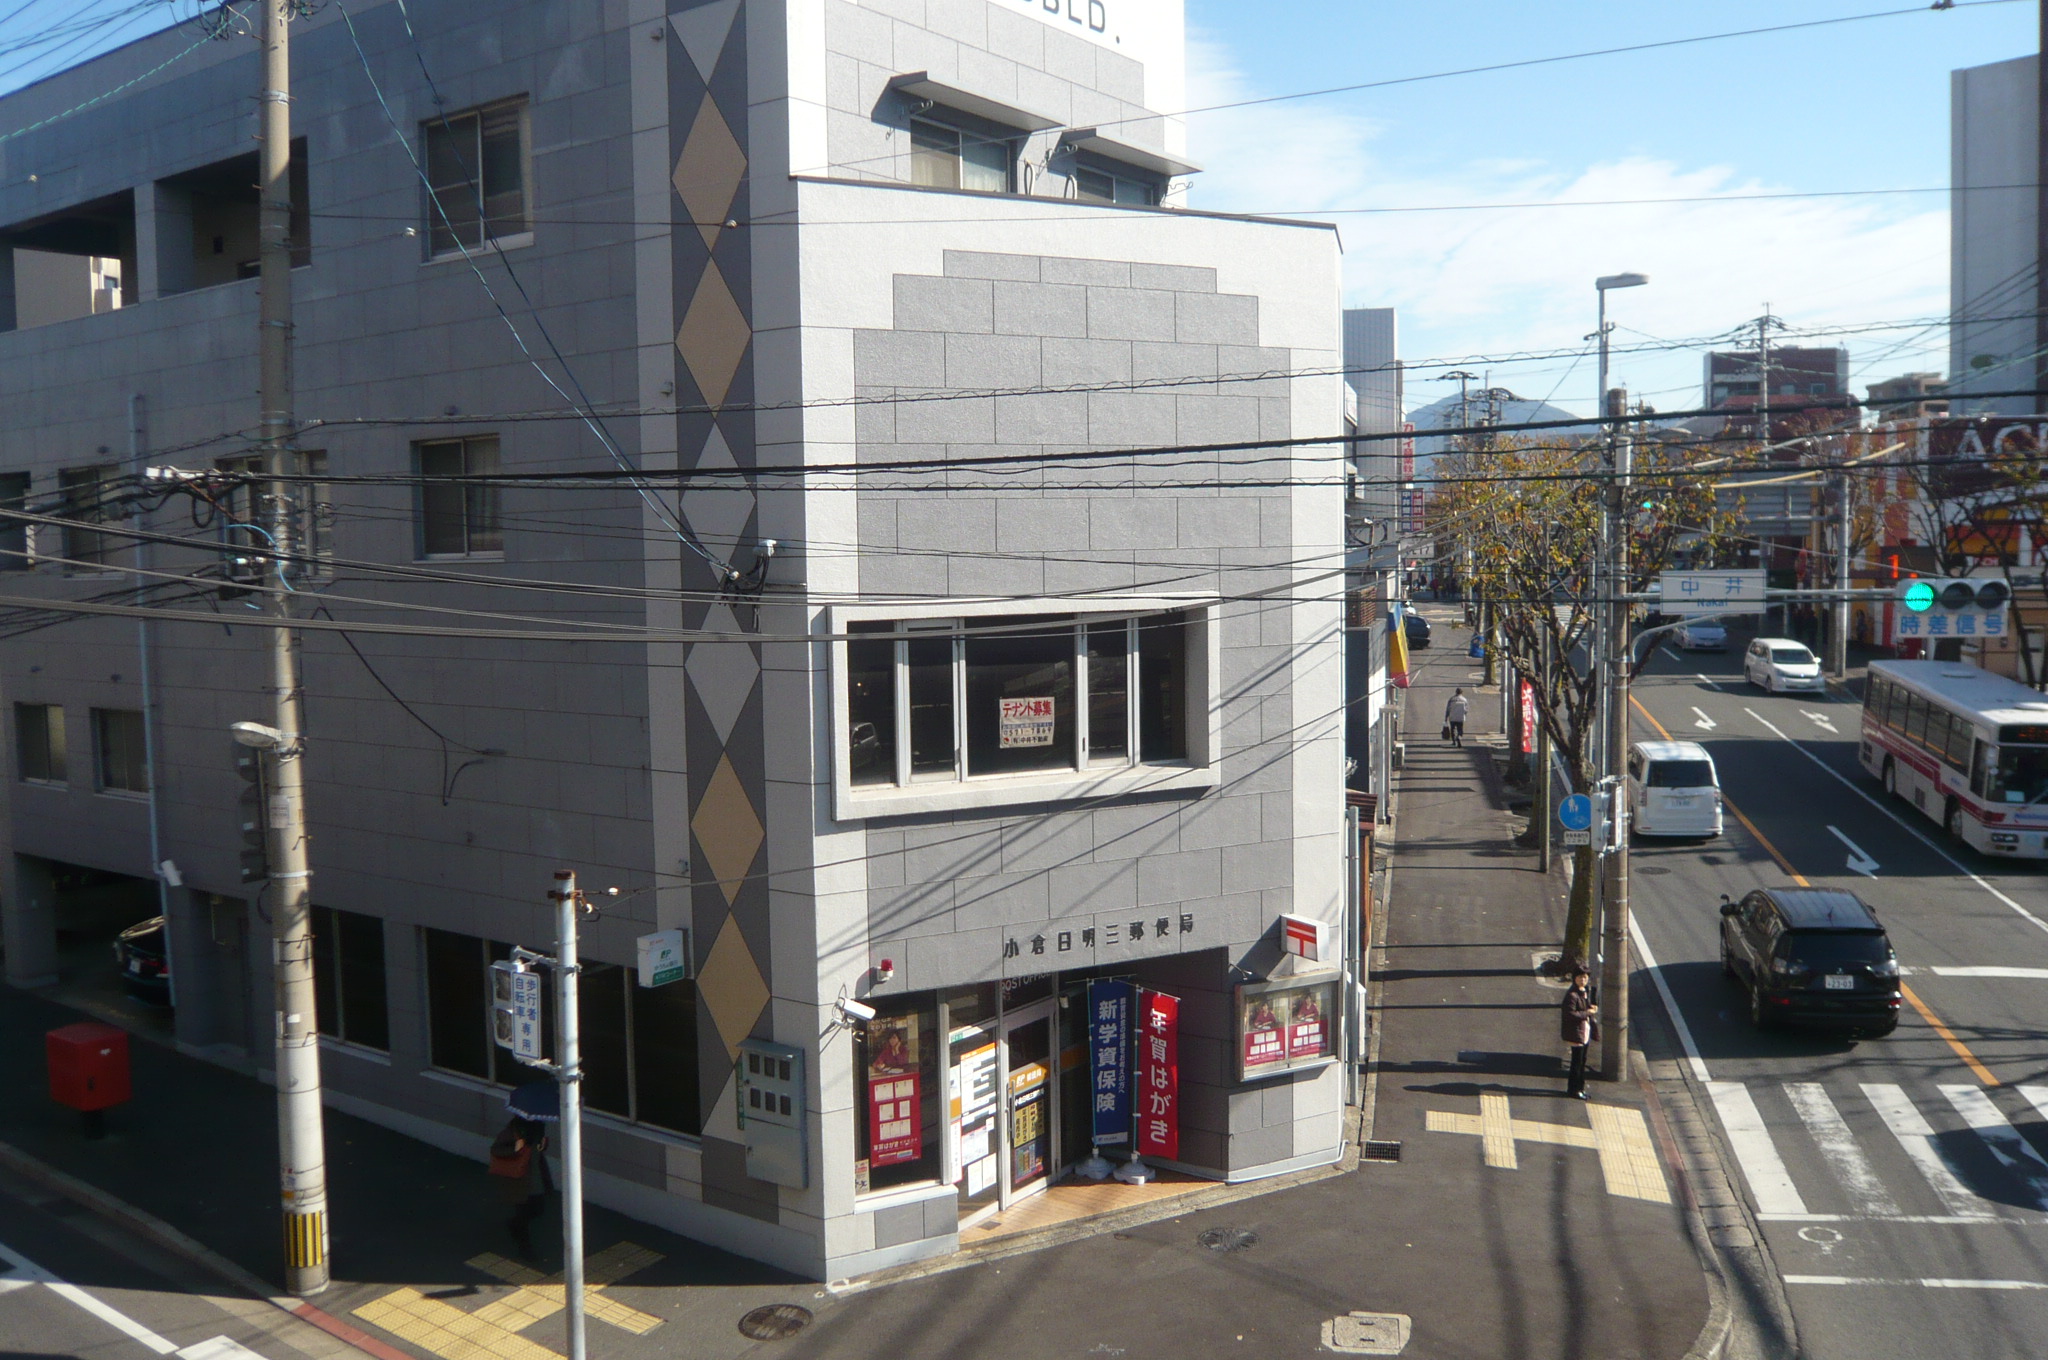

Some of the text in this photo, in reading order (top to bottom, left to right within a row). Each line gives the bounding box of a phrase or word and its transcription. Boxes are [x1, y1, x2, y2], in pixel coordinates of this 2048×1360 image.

[1681, 576, 1744, 596] 中井
[1697, 597, 1728, 608] Nakai
[1900, 614, 2004, 635] 時差信号
[1003, 700, 1052, 718] テナント募集
[1003, 912, 1195, 959] 小倉日明三郵便局
[514, 977, 526, 1019] 自転車
[526, 978, 537, 1022] 歩行者
[521, 1021, 532, 1053] 専用
[1096, 999, 1118, 1113] 新学資保険
[1149, 1007, 1173, 1145] 年賀はがき
